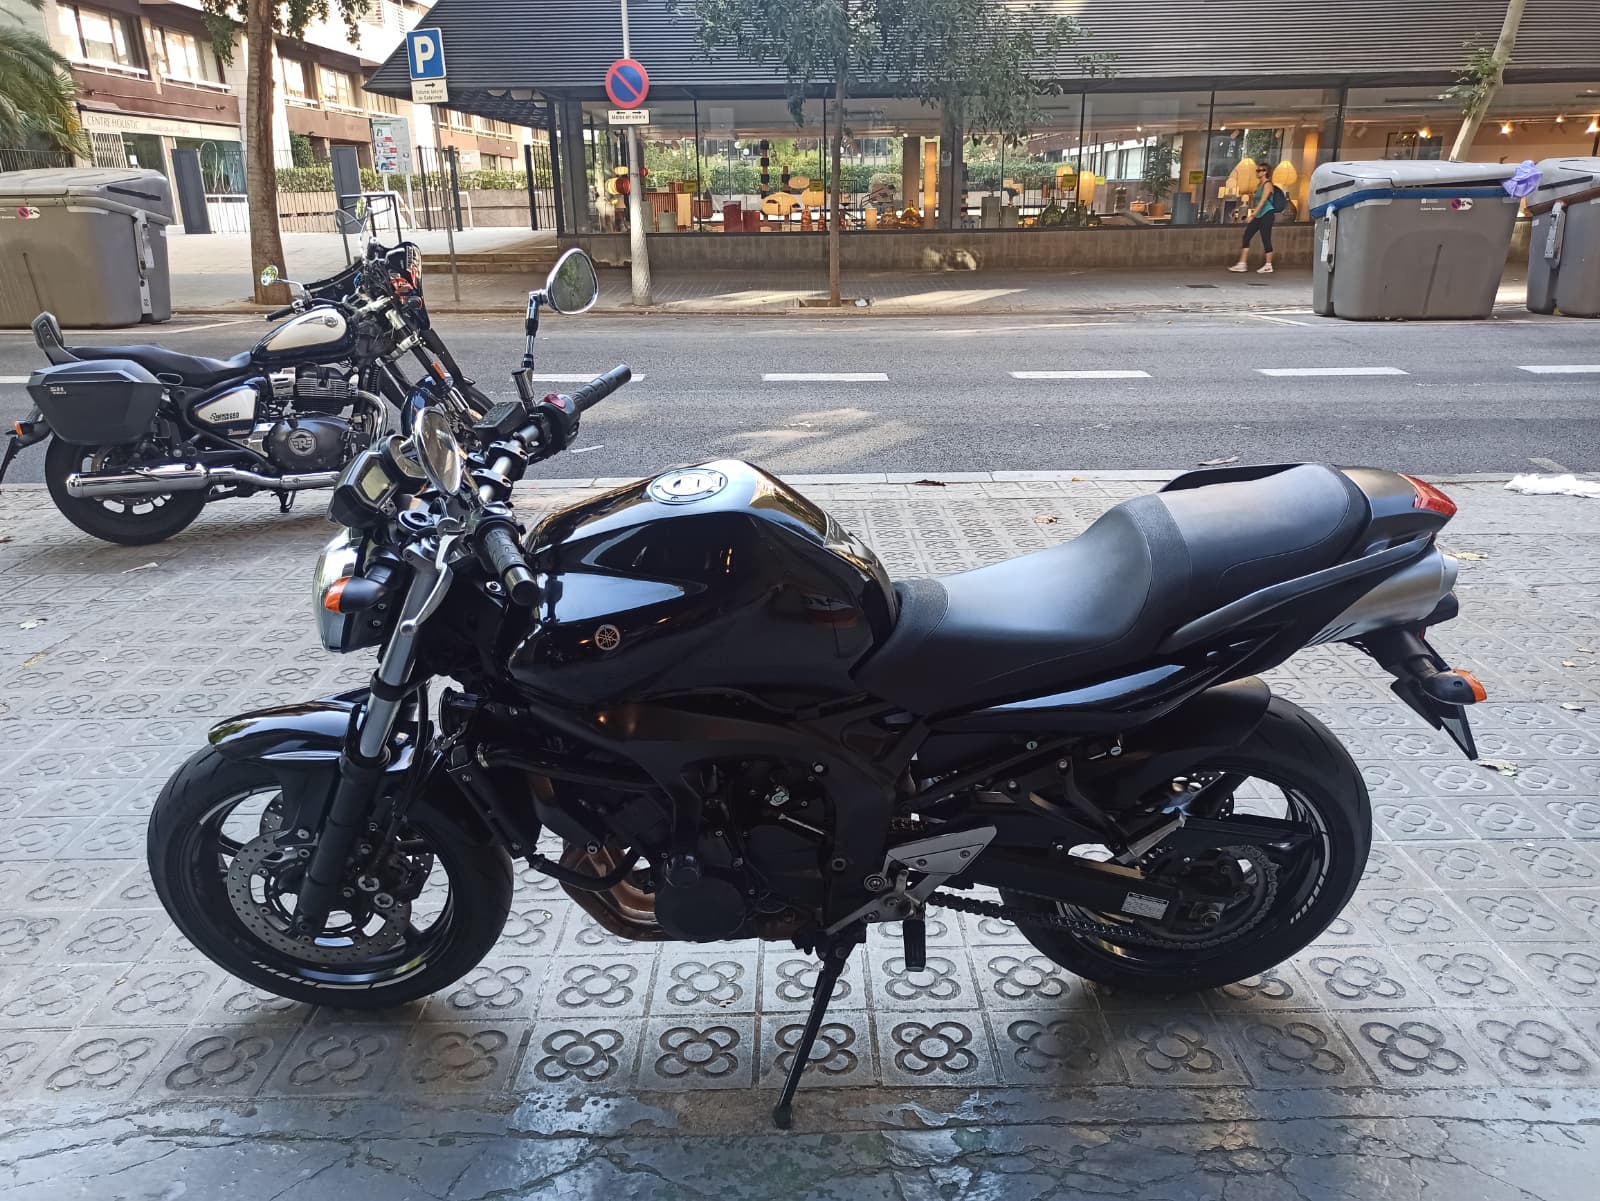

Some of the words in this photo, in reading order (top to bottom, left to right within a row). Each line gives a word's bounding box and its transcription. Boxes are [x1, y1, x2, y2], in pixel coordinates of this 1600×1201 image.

[413, 35, 435, 74] P
[86, 115, 111, 128] CENTRE
[112, 118, 140, 129] HOLISTIC
